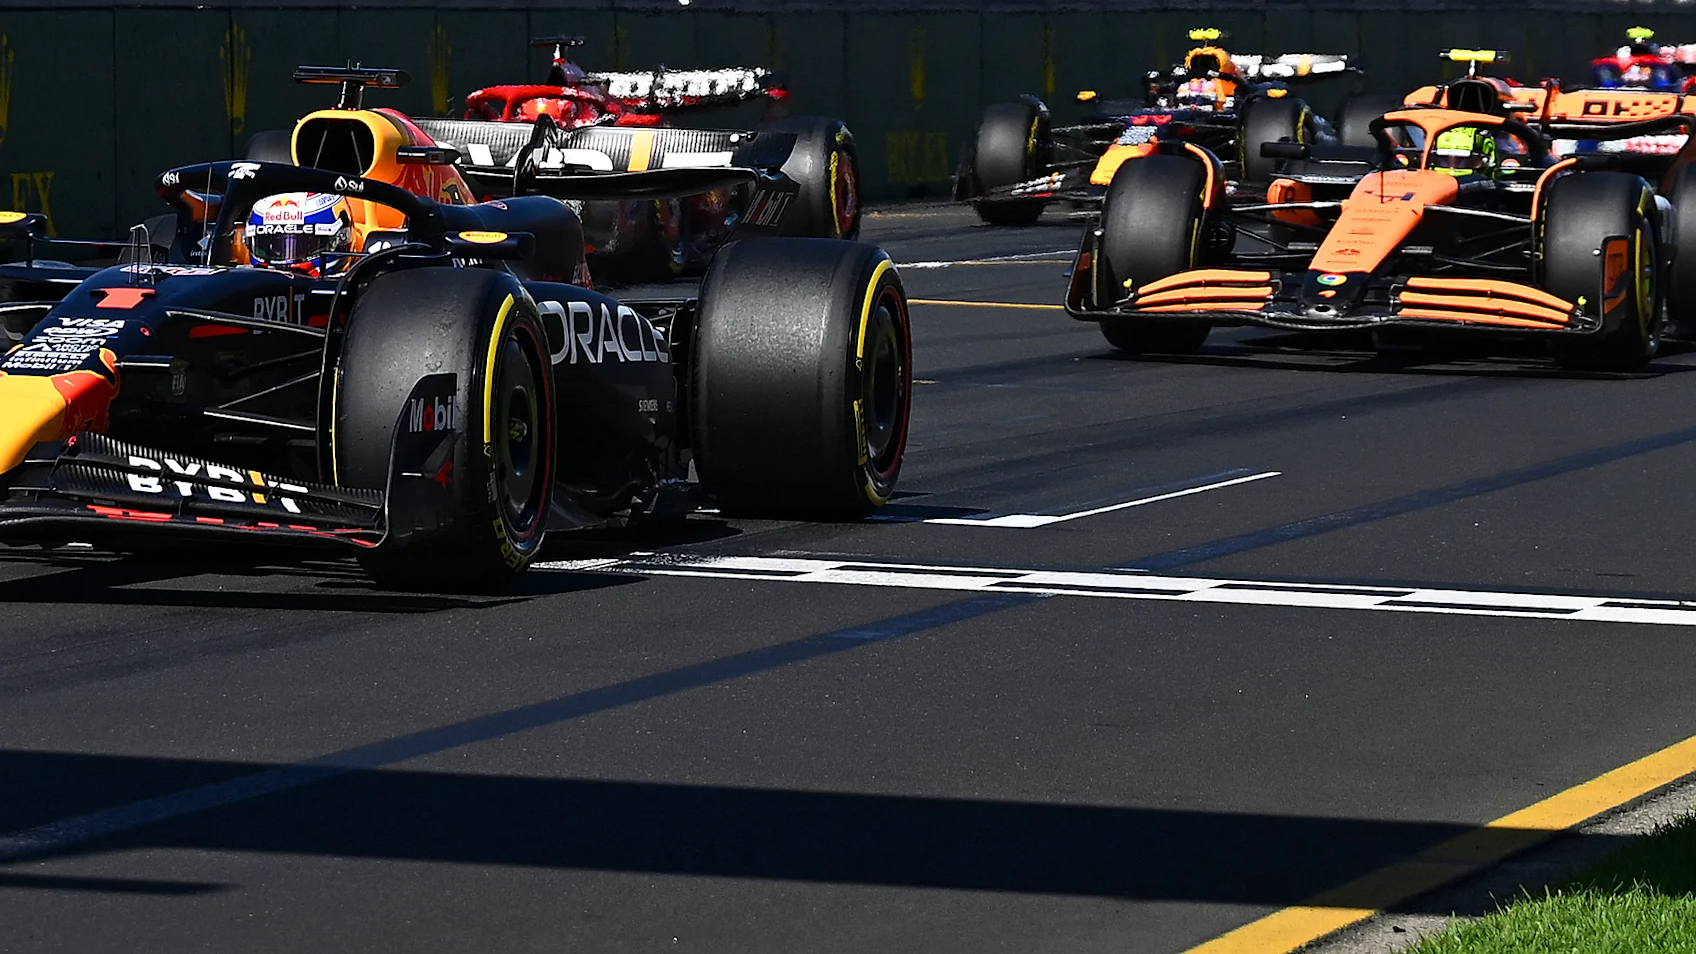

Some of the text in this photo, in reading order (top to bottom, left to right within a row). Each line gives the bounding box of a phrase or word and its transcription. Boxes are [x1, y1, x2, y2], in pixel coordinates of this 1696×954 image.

[265, 210, 303, 221] Red Bull
[256, 224, 314, 235] ORACLE
[58, 317, 127, 329] VISA
[409, 395, 457, 433] Mobil
[127, 456, 309, 514] BYBIT
